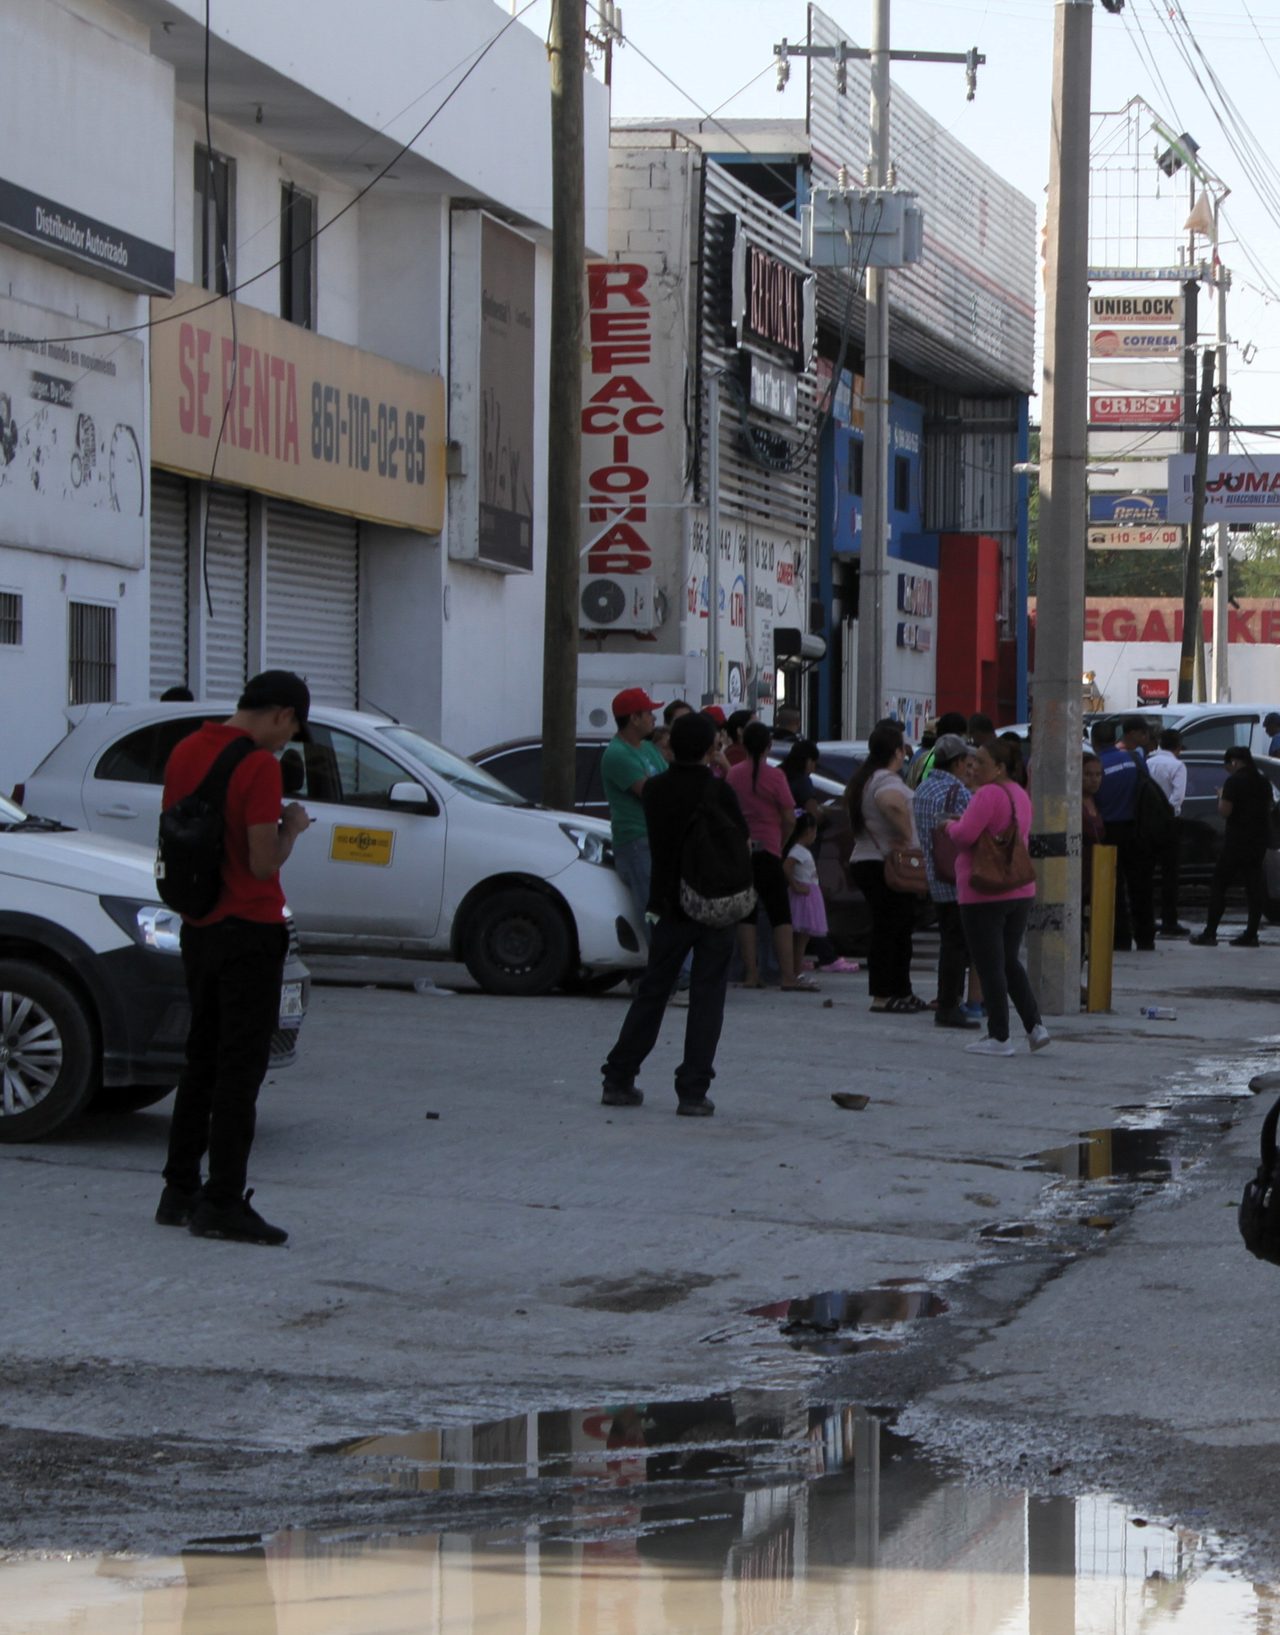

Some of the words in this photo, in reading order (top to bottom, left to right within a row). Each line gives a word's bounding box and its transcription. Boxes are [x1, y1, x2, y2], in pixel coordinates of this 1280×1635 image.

[36, 206, 85, 250] Distribuidor
[86, 228, 129, 267] Autorizado
[751, 246, 799, 351] REFORMA
[1094, 299, 1175, 315] UNIBLOCK
[1123, 335, 1179, 346] COTRESA
[178, 322, 212, 439] SE
[221, 337, 300, 466] RENTA
[312, 381, 426, 486] 861-110-02-85
[1094, 397, 1177, 414] CREST
